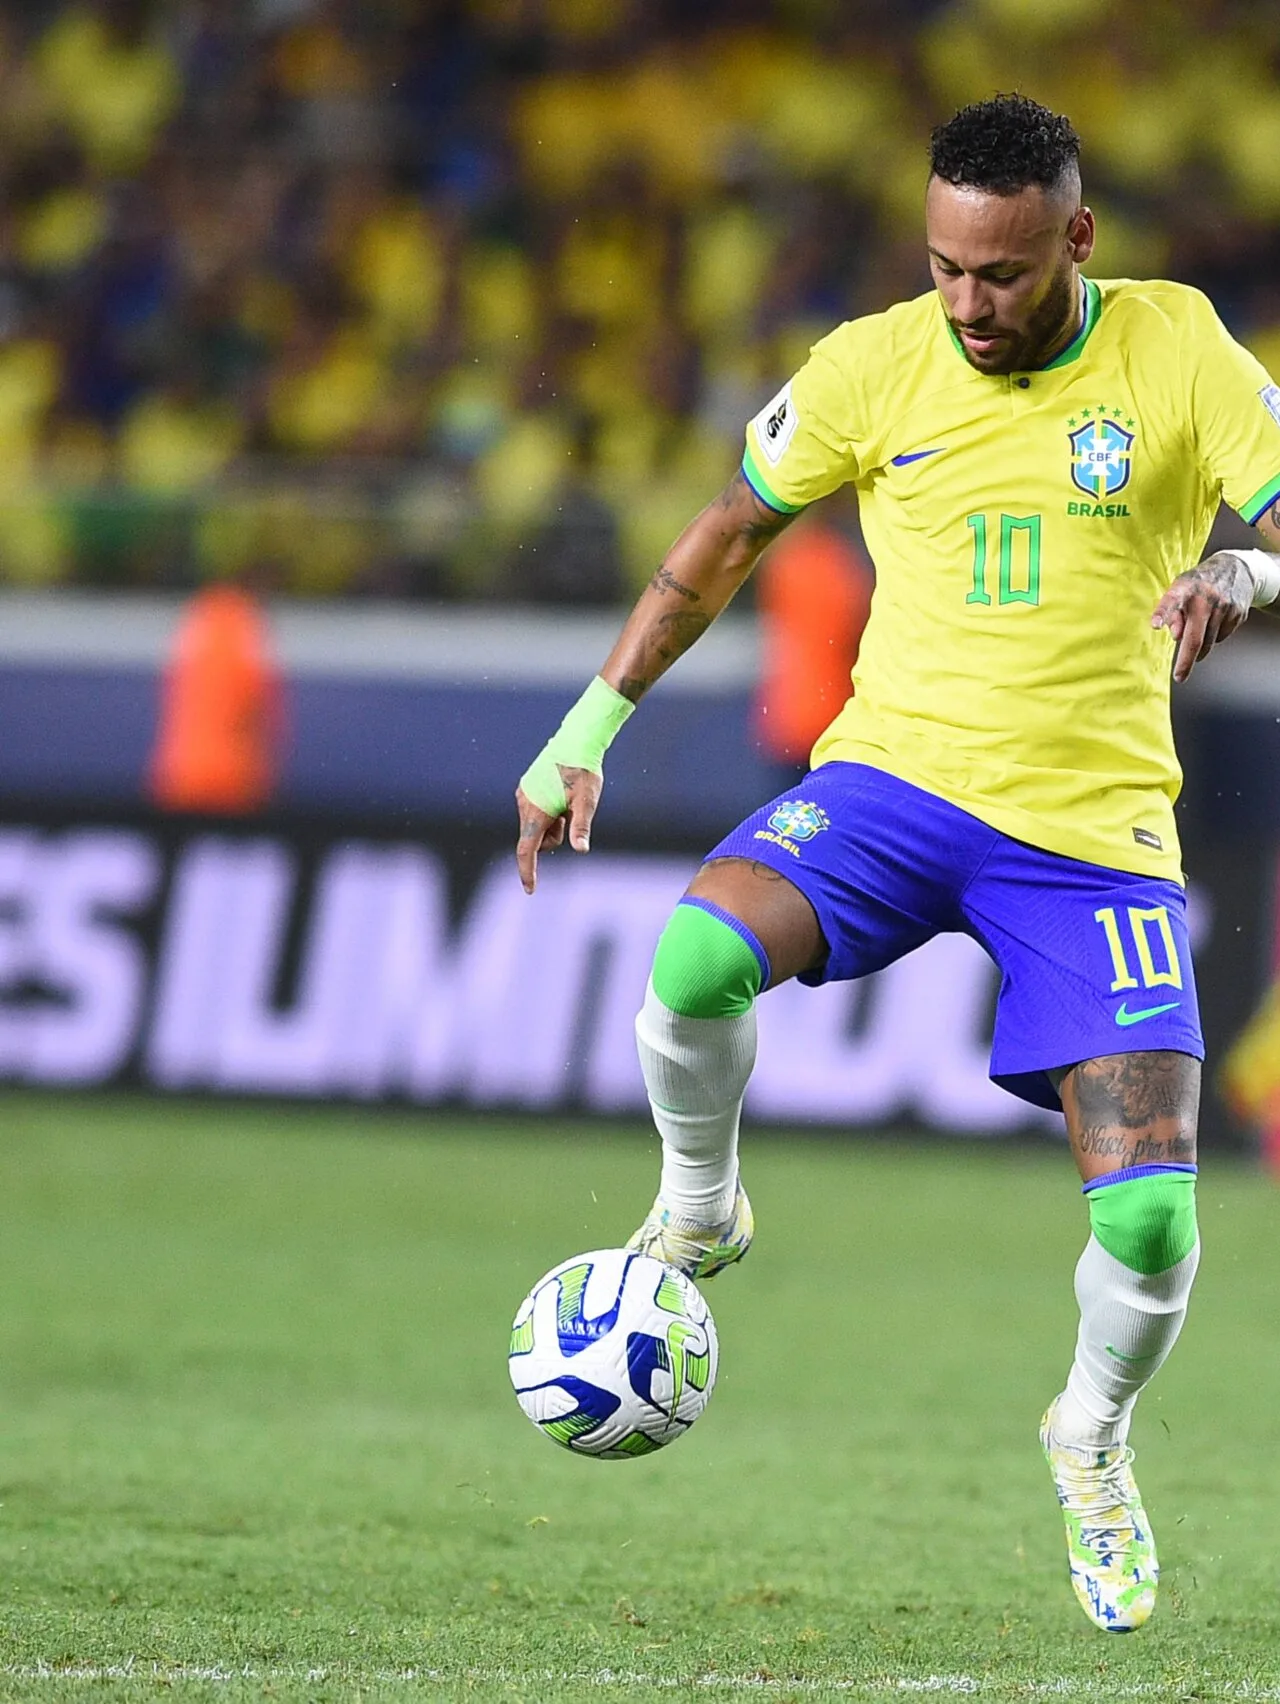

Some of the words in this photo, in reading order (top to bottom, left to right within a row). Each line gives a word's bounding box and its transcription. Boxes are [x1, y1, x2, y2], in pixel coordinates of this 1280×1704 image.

[1088, 452, 1112, 462] CBF
[1067, 502, 1131, 517] BRASIL
[965, 513, 1041, 606] 10
[754, 830, 800, 858] BRASIL
[1094, 906, 1183, 992] 10
